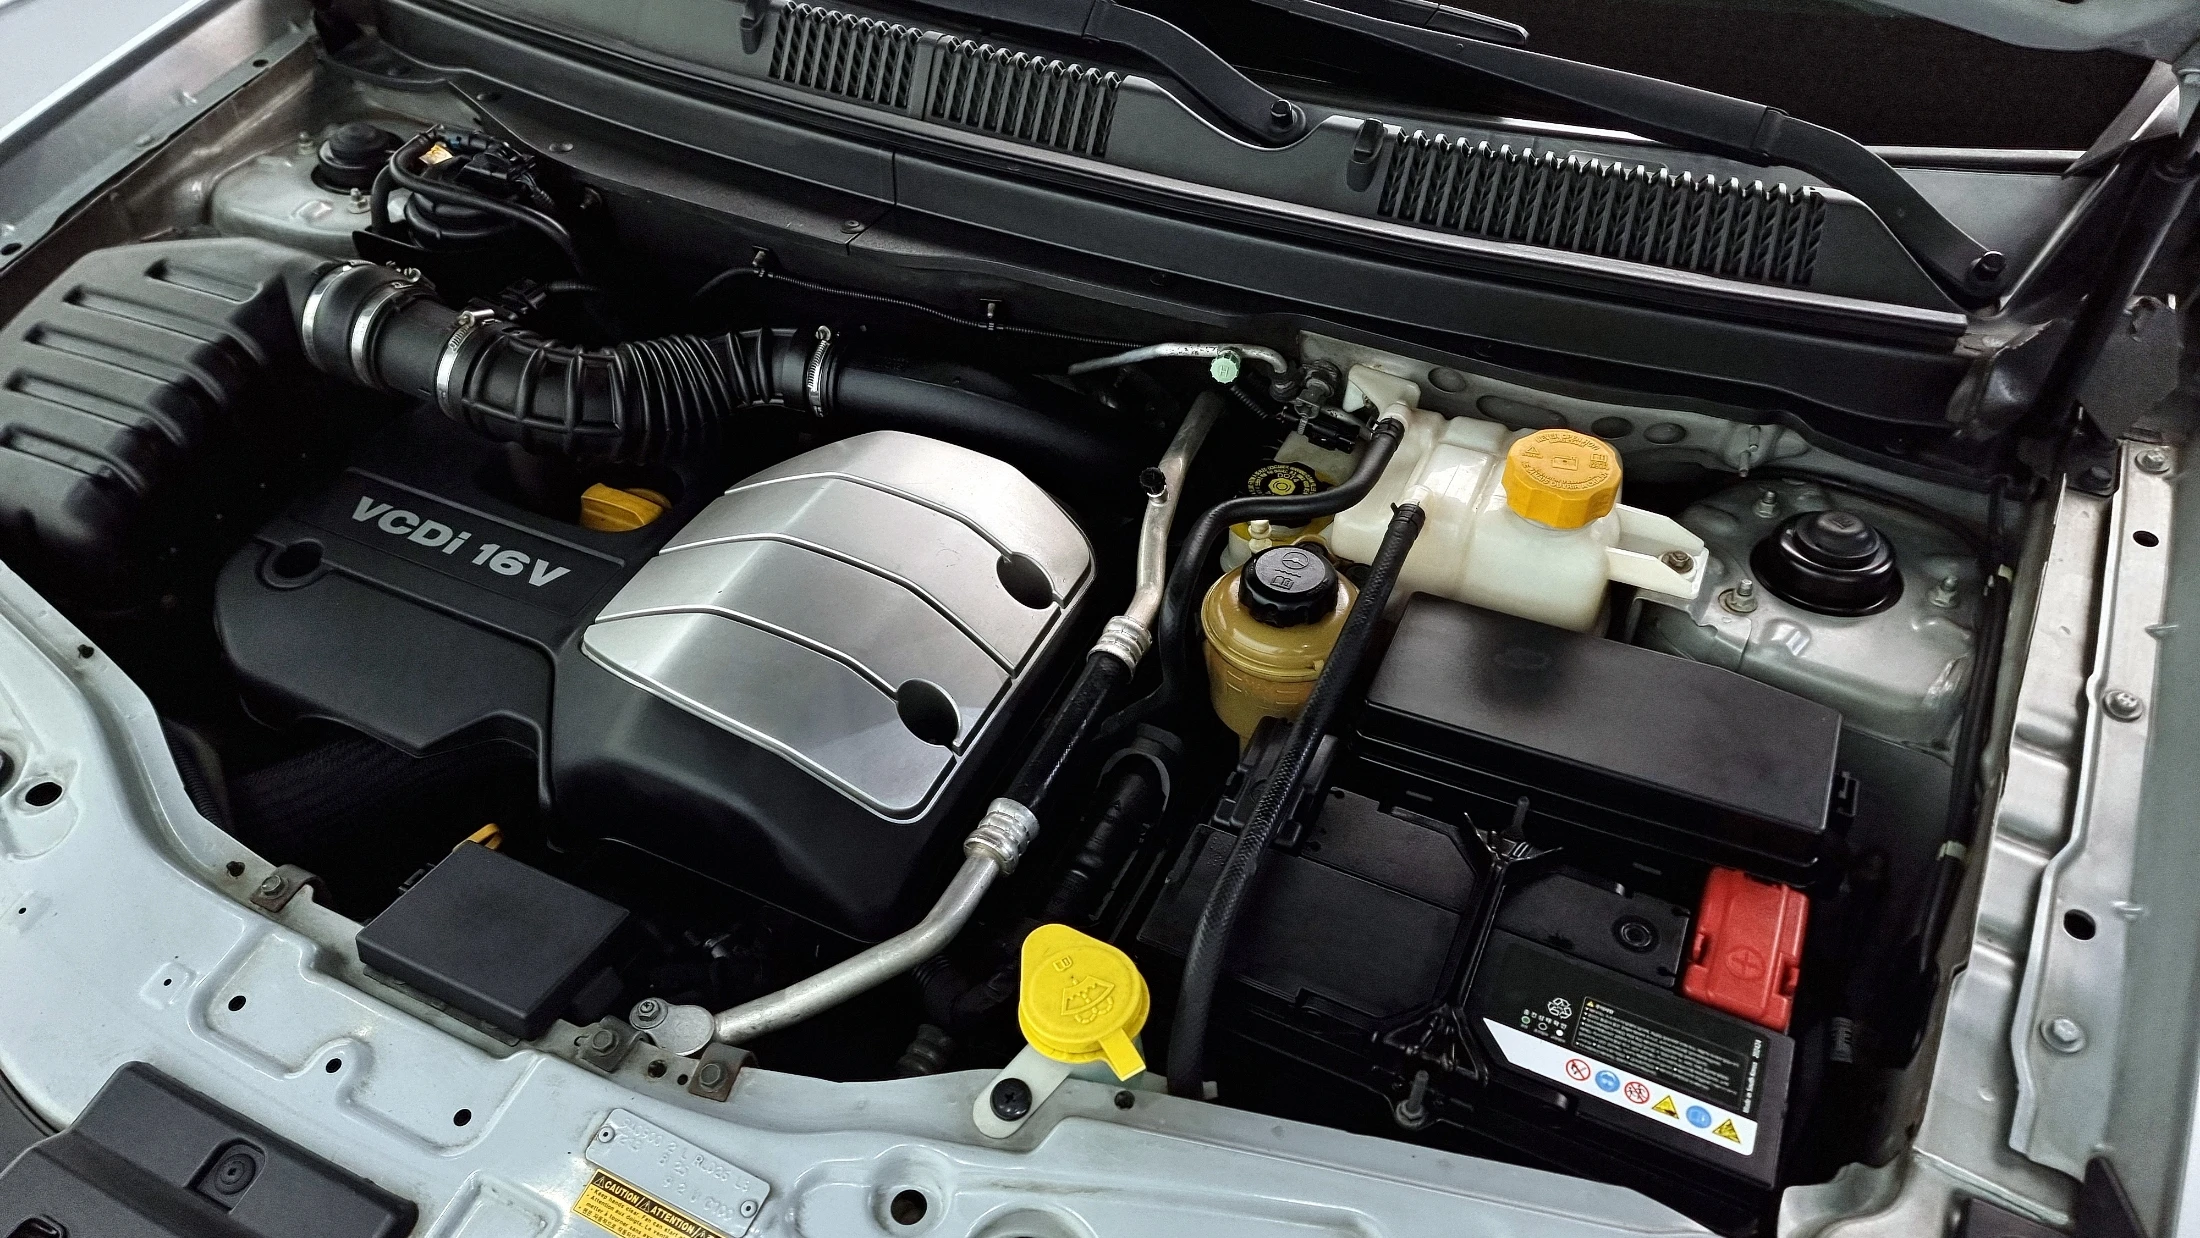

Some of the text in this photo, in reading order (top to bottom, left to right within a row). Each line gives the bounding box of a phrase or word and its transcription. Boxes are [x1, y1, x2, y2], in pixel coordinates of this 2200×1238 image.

[1219, 365, 1230, 378] H
[352, 495, 572, 587] VCDi 16V
[590, 1195, 615, 1212] Attention
[593, 1188, 608, 1200] Keep
[608, 1196, 625, 1209] hands
[641, 1213, 652, 1223] Fan
[652, 1220, 663, 1230] can
[609, 1212, 629, 1227] tourner
